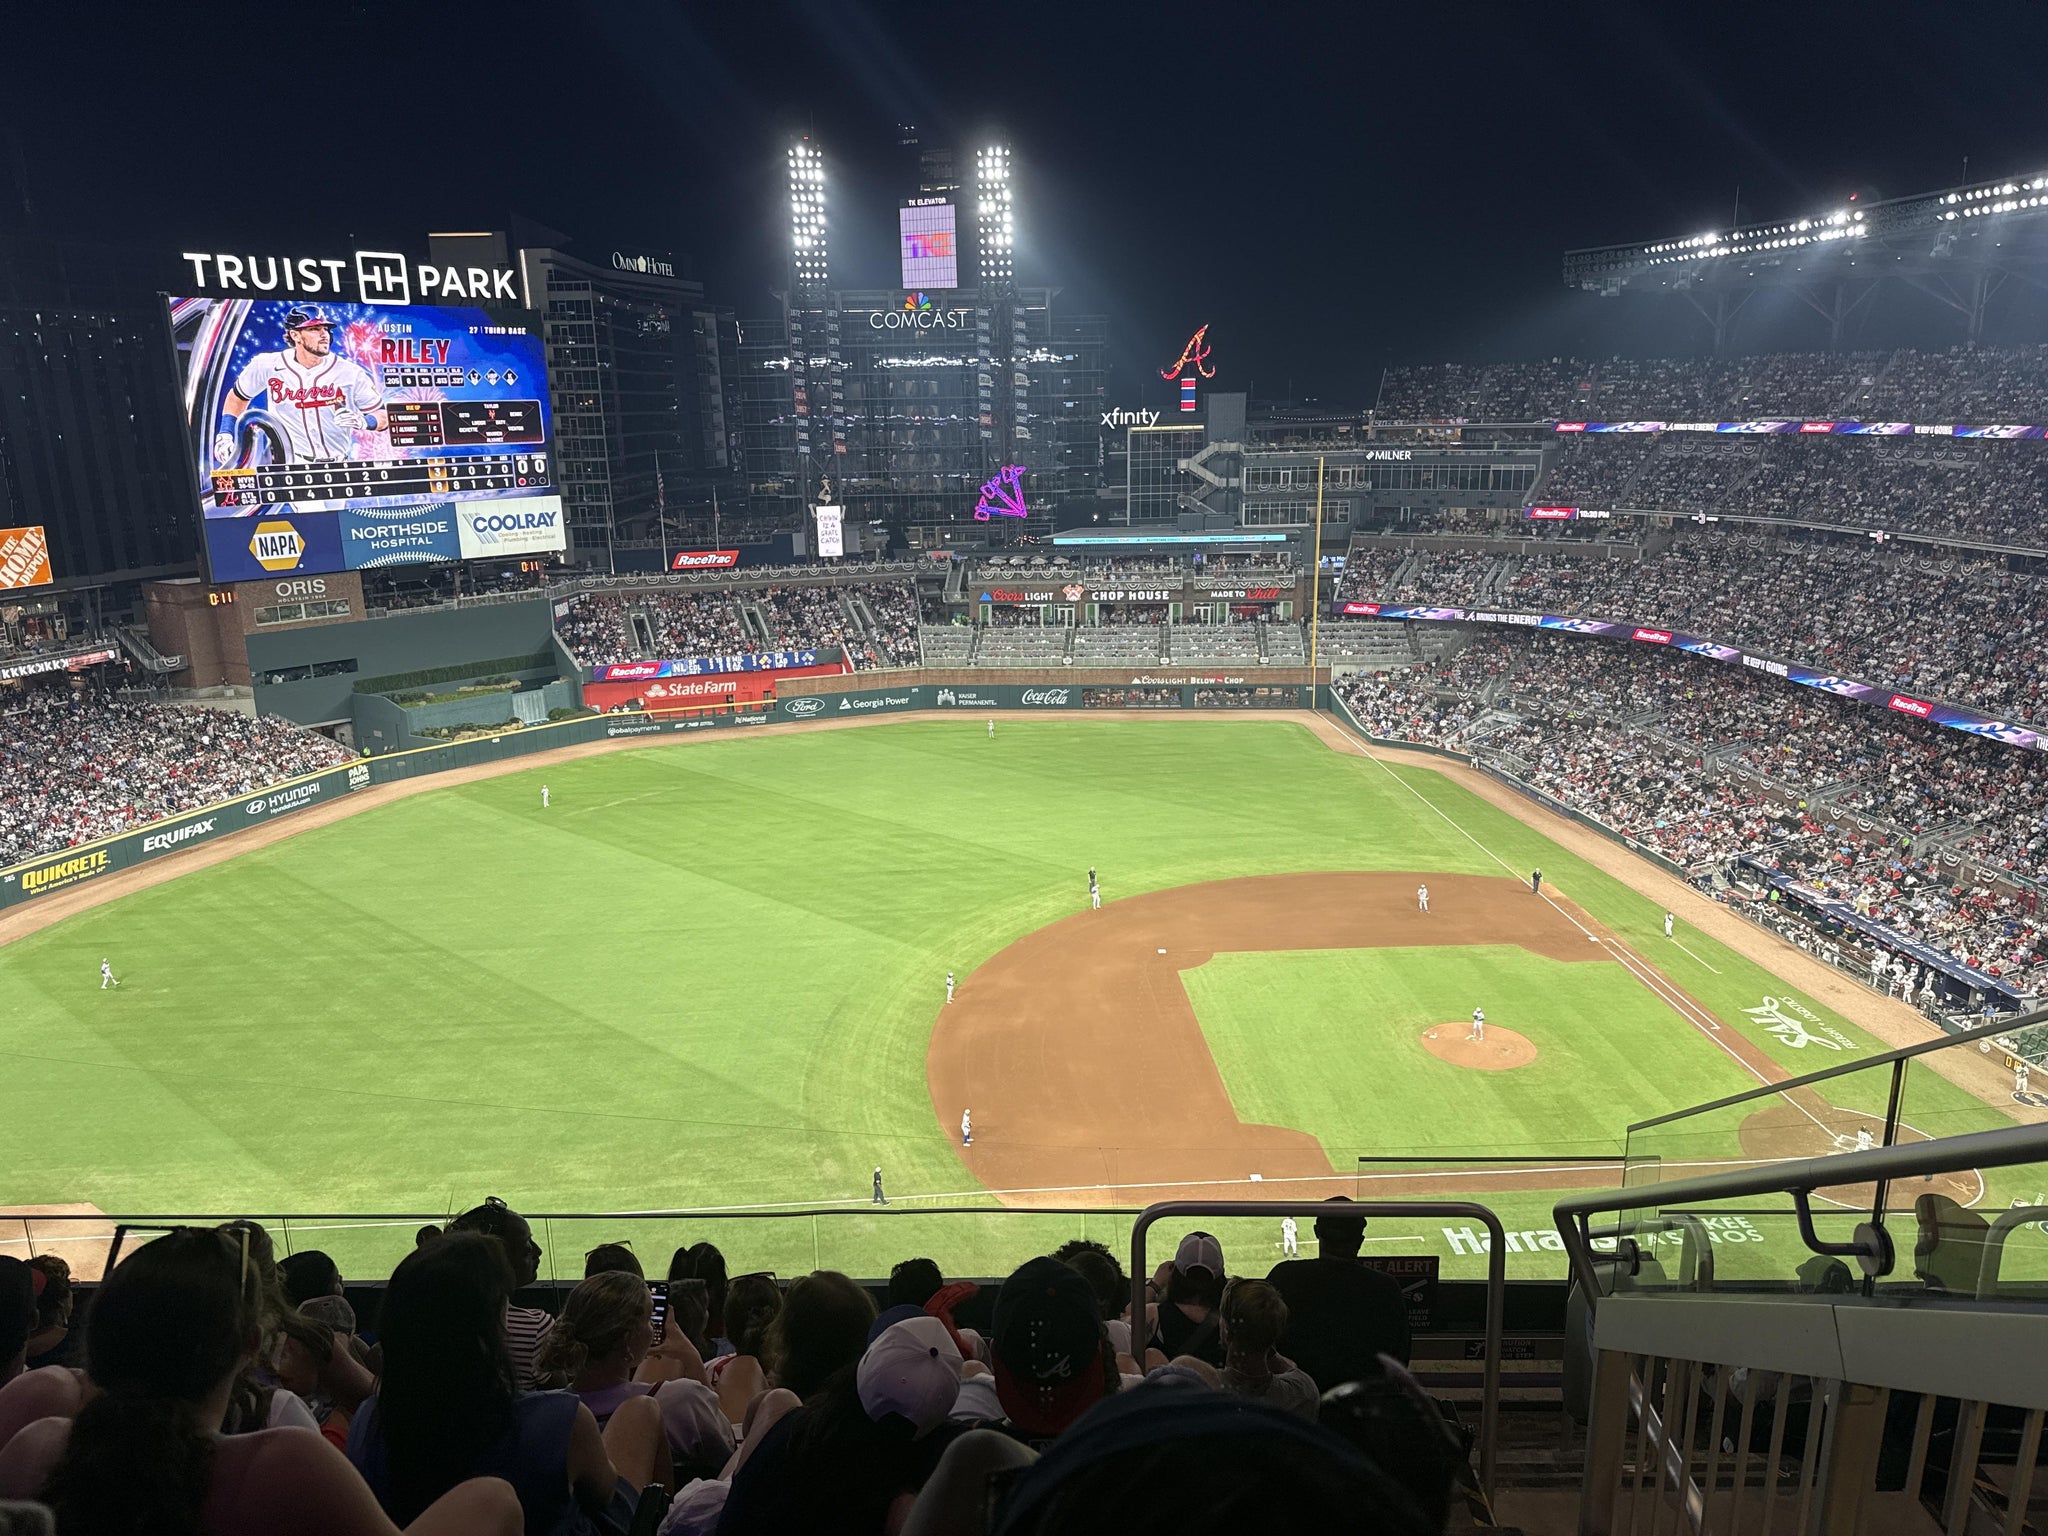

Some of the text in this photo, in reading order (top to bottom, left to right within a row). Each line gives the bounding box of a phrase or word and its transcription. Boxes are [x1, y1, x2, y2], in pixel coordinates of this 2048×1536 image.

[908, 198, 946, 207] TK ELEVATOR
[182, 252, 517, 299] TRUIST PARK
[869, 311, 968, 329] COMCAST
[378, 324, 412, 333] AUSTIN
[484, 326, 506, 334] THIRD
[508, 327, 526, 335] BASE
[380, 338, 451, 364] RILEY
[268, 378, 335, 403] Braves
[1101, 407, 1160, 429] xfinity
[1934, 425, 1952, 434] GOING
[1375, 450, 1411, 460] MILNER
[518, 460, 528, 473] 0
[534, 459, 545, 473] 0
[237, 476, 255, 485] NYM
[265, 476, 273, 487] 0
[285, 475, 293, 486] 0
[305, 474, 313, 485] 0
[325, 473, 332, 484] 0
[344, 472, 350, 482] 1
[362, 471, 370, 481] 2
[380, 470, 388, 480] 0
[434, 467, 441, 476] 3
[451, 467, 458, 476] 7
[468, 466, 476, 475] 0
[485, 465, 492, 474] 7
[501, 464, 509, 474] 0
[240, 492, 257, 500] ATL
[267, 491, 275, 502] 0
[288, 490, 294, 500] 1
[307, 489, 315, 499] 4
[327, 488, 333, 498] 1
[345, 487, 353, 497] 0
[364, 486, 372, 496] 2
[436, 481, 443, 491] 8
[453, 480, 460, 490] 8
[470, 479, 476, 489] 1
[486, 479, 494, 488] 4
[504, 478, 509, 487] 1
[473, 511, 556, 533] COOLRAY
[351, 521, 448, 540] NORTHSIDE
[1, 535, 19, 559] THE
[258, 534, 298, 557] NAPA
[371, 536, 433, 549] HOSPITAL
[0, 527, 45, 588] HOME
[678, 554, 732, 566] RaceTrac
[18, 548, 48, 586] DEPOT
[521, 561, 538, 572] 0:11
[275, 578, 326, 597] ORIS
[1211, 587, 1280, 599] MADE TO Chill
[209, 592, 232, 606] 0:11
[992, 589, 1054, 601] Coors LIGHT
[1092, 590, 1170, 600] CHOP HOUSE
[1454, 611, 1464, 620] THE
[1497, 614, 1508, 623] THE
[1508, 614, 1543, 625] ENERGY
[1637, 631, 1668, 641] RaceTrac
[611, 666, 656, 677] RaceTrac
[672, 663, 686, 673] NL
[1765, 660, 1788, 677] GOING
[1142, 675, 1166, 685] Coors
[1224, 676, 1244, 684] CHOP
[668, 680, 737, 697] State Farm
[792, 700, 818, 712] Ford
[853, 696, 909, 709] Georgia Power
[1893, 698, 1927, 714] RaceTrac
[348, 765, 369, 778] PAPA
[349, 774, 370, 787] JOHNS
[268, 782, 321, 808] HYUNDAI
[143, 819, 214, 852] EQUIFAX
[22, 849, 108, 890] QUIKRETE
[30, 870, 95, 895] What America's Made
[1778, 996, 1860, 1049] FREIGHT LOGISTICS
[1387, 1260, 1433, 1273] ALERT
